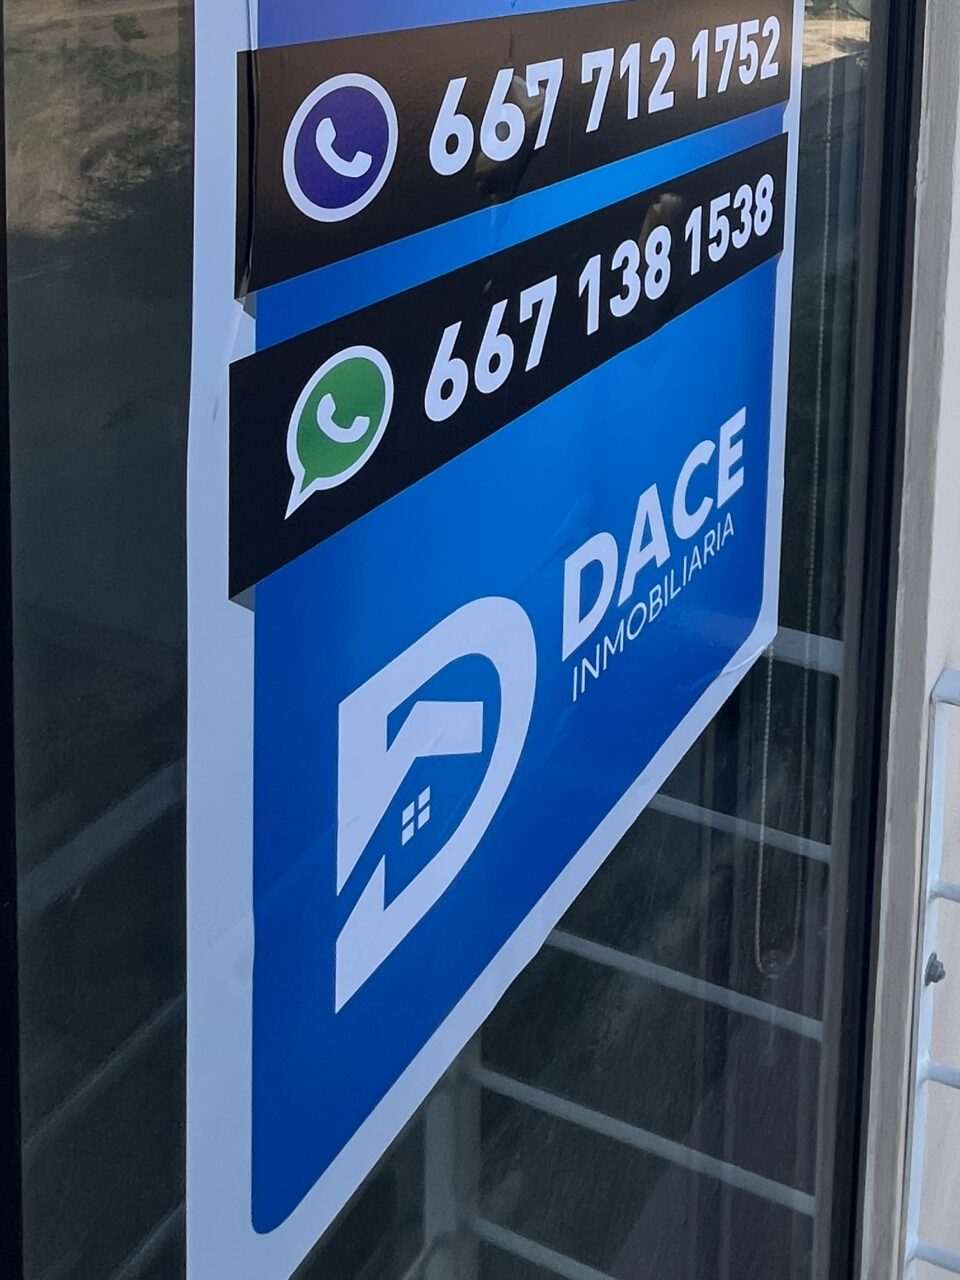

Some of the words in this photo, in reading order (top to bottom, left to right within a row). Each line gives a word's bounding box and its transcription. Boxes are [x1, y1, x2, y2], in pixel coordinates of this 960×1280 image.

[429, 59, 563, 176] 667
[581, 36, 676, 134] 712
[691, 15, 781, 99] 1752
[423, 275, 557, 422] 667
[577, 225, 672, 336] 138
[685, 173, 775, 276] 1538
[562, 406, 747, 662] DACE
[572, 512, 735, 702] INMOBILIARIA
